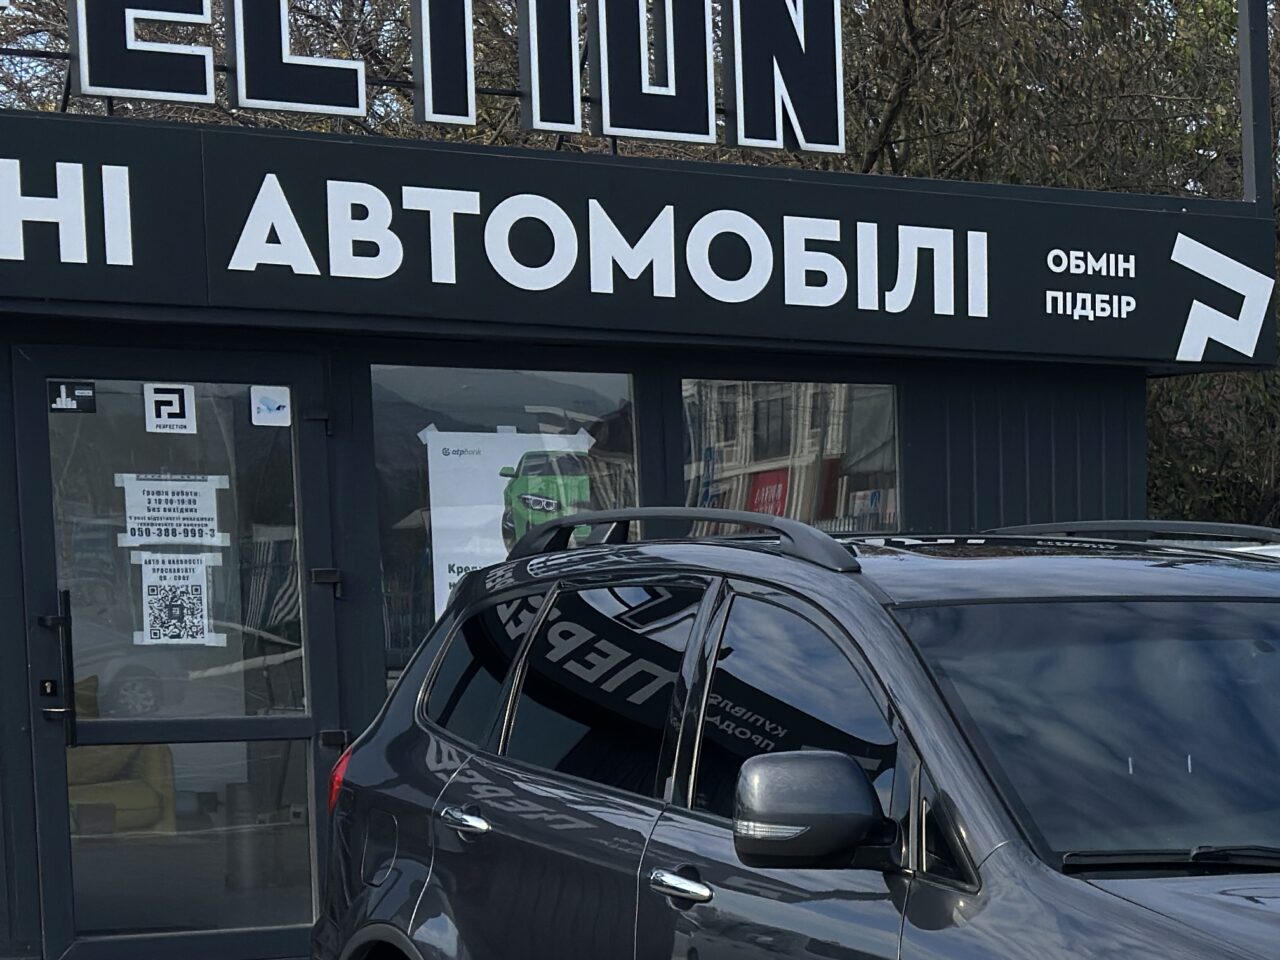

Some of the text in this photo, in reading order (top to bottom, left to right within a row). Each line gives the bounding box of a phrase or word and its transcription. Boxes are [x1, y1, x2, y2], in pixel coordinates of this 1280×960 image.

[228, 172, 989, 318] АВТОМОБІЛІ
[1046, 248, 1136, 279] ОБМІН
[1045, 290, 1137, 321] ПІДБІР
[130, 527, 216, 538] 050-388-999-3
